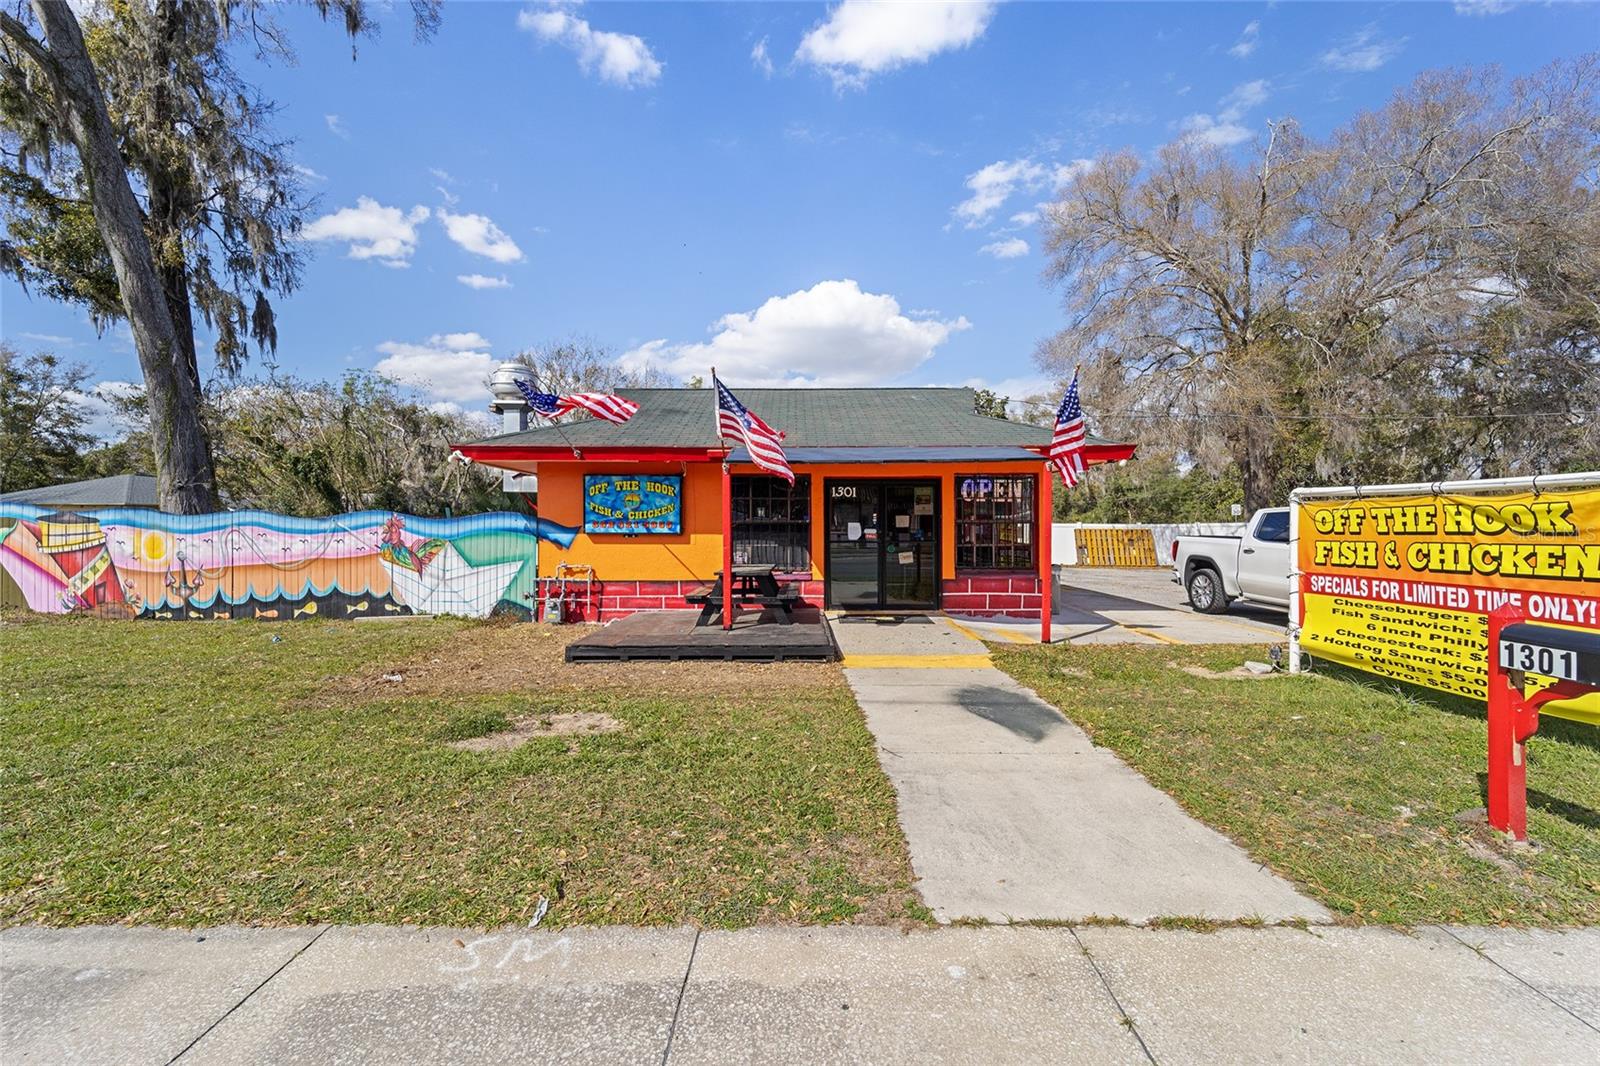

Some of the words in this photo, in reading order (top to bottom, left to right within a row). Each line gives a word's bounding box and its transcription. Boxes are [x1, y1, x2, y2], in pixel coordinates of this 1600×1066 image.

[589, 481, 609, 497] OFF
[615, 480, 640, 492] THE
[646, 481, 676, 497] HOOK
[831, 486, 857, 498] 1301
[960, 478, 1023, 502] OPEN
[589, 501, 612, 518] FISH
[614, 510, 624, 519] &
[628, 502, 675, 520] CHICKEN
[1314, 508, 1366, 535] OFF
[1370, 504, 1438, 536] THE
[1444, 501, 1579, 536] HOOK
[1314, 540, 1379, 569] FISH
[1384, 540, 1401, 570] &
[1407, 541, 1600, 582] CHICKEN
[1310, 575, 1368, 597] SPECIALS
[1372, 581, 1400, 600] FOR
[1404, 583, 1469, 608] LIMITED
[1473, 588, 1522, 611] TIME
[1528, 598, 1598, 624] ONLY!
[1334, 598, 1470, 623] Cheeseburger:
[1331, 607, 1364, 619] Fish
[1369, 613, 1472, 635] Sandwich:
[1310, 633, 1319, 641] 2
[1323, 635, 1383, 655] Hotdog
[1335, 628, 1462, 658] Cheesesteak:
[1366, 623, 1377, 631] 6
[1382, 625, 1422, 639] Inch
[1428, 633, 1489, 651] Philly
[1354, 652, 1364, 661] 5
[1370, 655, 1434, 677] Wings:
[1440, 670, 1488, 687] $5.0
[1504, 643, 1572, 679] 1301
[1372, 664, 1421, 682] Gyro:
[1427, 678, 1486, 698] $5.00
